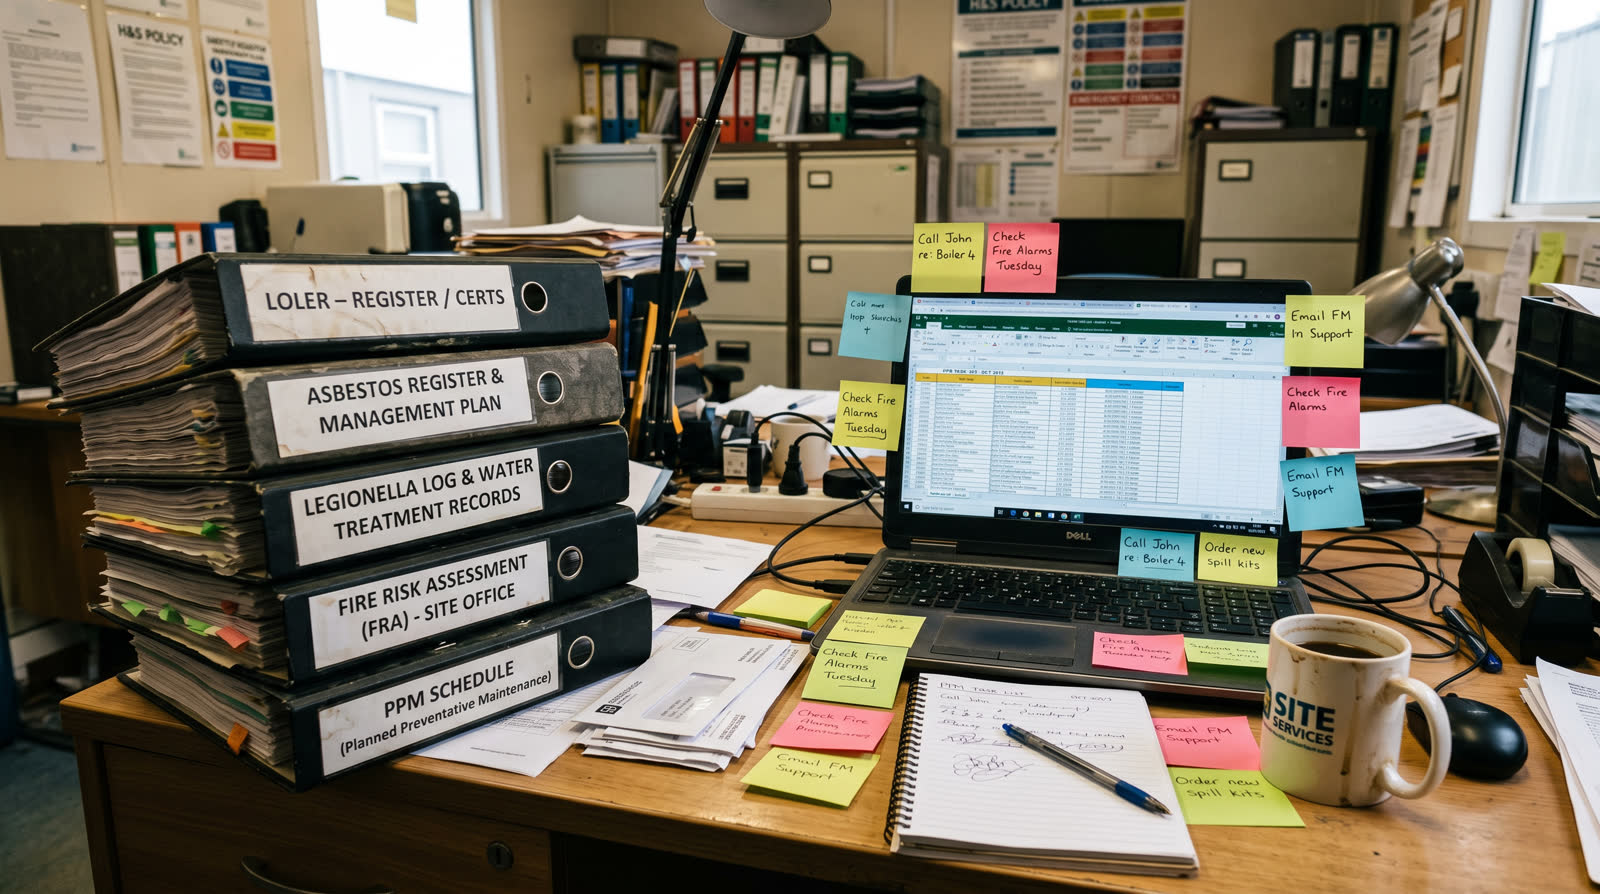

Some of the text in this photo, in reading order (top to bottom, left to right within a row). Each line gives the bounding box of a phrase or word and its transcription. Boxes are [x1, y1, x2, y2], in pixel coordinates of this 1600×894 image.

[118, 24, 184, 47] H&S POLICY
[918, 232, 972, 244] Call John
[992, 232, 1026, 242] Check
[918, 249, 976, 260] re: Boiler 4
[992, 245, 1053, 256] Fire Alarms
[996, 260, 1042, 276] Tuesday
[265, 292, 330, 311] LOLER
[352, 289, 439, 309] REGISTER
[444, 288, 450, 310] /
[456, 288, 505, 306] CERTS
[1291, 310, 1351, 321] Email FM
[1292, 328, 1353, 342] In Support
[307, 368, 504, 405] ASBESTOS REGISTER &
[1287, 386, 1348, 397] Check Fire
[842, 392, 896, 405] Check Fire
[843, 407, 878, 418] Alarms
[1289, 402, 1327, 411] Alarms
[319, 394, 502, 434] MANAGEMENT PLAN
[845, 422, 887, 439] Tuesday
[1287, 467, 1344, 482] Email FM
[304, 457, 534, 516] LEGIONELLA LOG & WATER
[1292, 485, 1334, 500] Support
[333, 486, 521, 540] TREATMENT RECORDS
[1066, 531, 1092, 541] DELL
[1124, 536, 1181, 551] Call John
[1205, 542, 1265, 556] Order new
[1144, 554, 1174, 565] Boiler
[1177, 558, 1186, 567] 4
[1238, 560, 1260, 570] kits
[338, 554, 529, 617] FIRE RISK ASSESSMENT
[361, 608, 409, 643] (FRA)
[424, 597, 459, 622] SITE
[462, 582, 516, 611] OFFICE
[1100, 637, 1139, 645] Check
[823, 648, 888, 662] Check Fire
[824, 658, 869, 671] Alarms
[824, 671, 876, 688] Tuesday
[384, 660, 515, 719] PPM SCHEDULE
[340, 727, 398, 758] (Planned
[400, 699, 475, 735] Preventative
[478, 670, 552, 707] Maintenance)
[798, 709, 869, 724] Check Fire
[1274, 691, 1336, 733] SITE
[800, 718, 839, 729] Alarms
[1154, 724, 1232, 735] Email FM
[1273, 716, 1334, 747] SERVICES
[1167, 735, 1221, 744] Support
[777, 754, 854, 773] Email FM
[776, 764, 838, 780] Support
[1176, 776, 1218, 785] Order
[1229, 789, 1265, 798] kits
